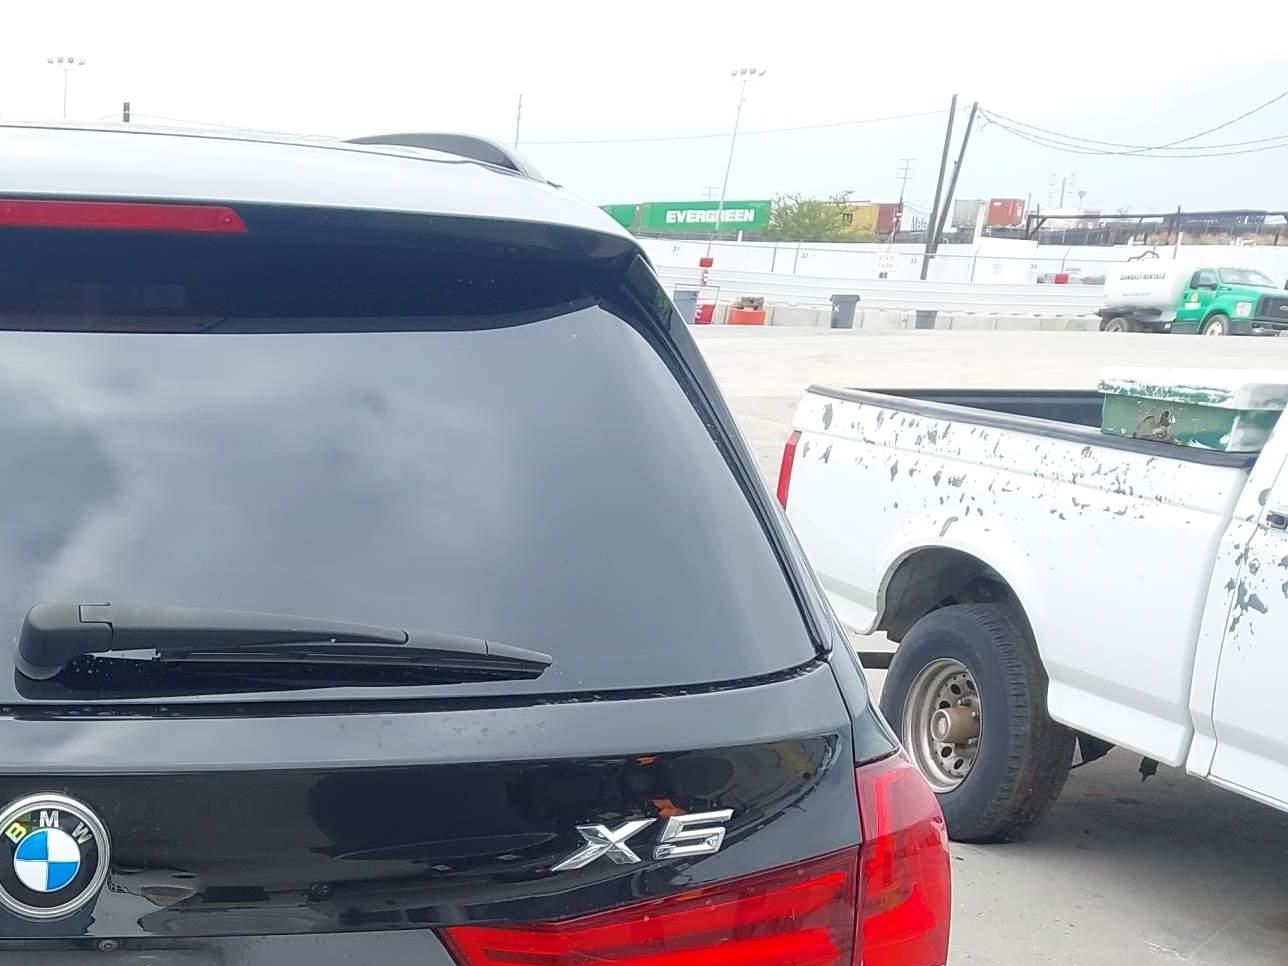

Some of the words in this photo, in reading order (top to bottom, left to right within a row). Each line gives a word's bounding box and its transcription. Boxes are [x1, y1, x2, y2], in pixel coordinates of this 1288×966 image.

[665, 208, 755, 224] EVERGREEN
[5, 810, 93, 845] BMW
[550, 809, 734, 861] X5
